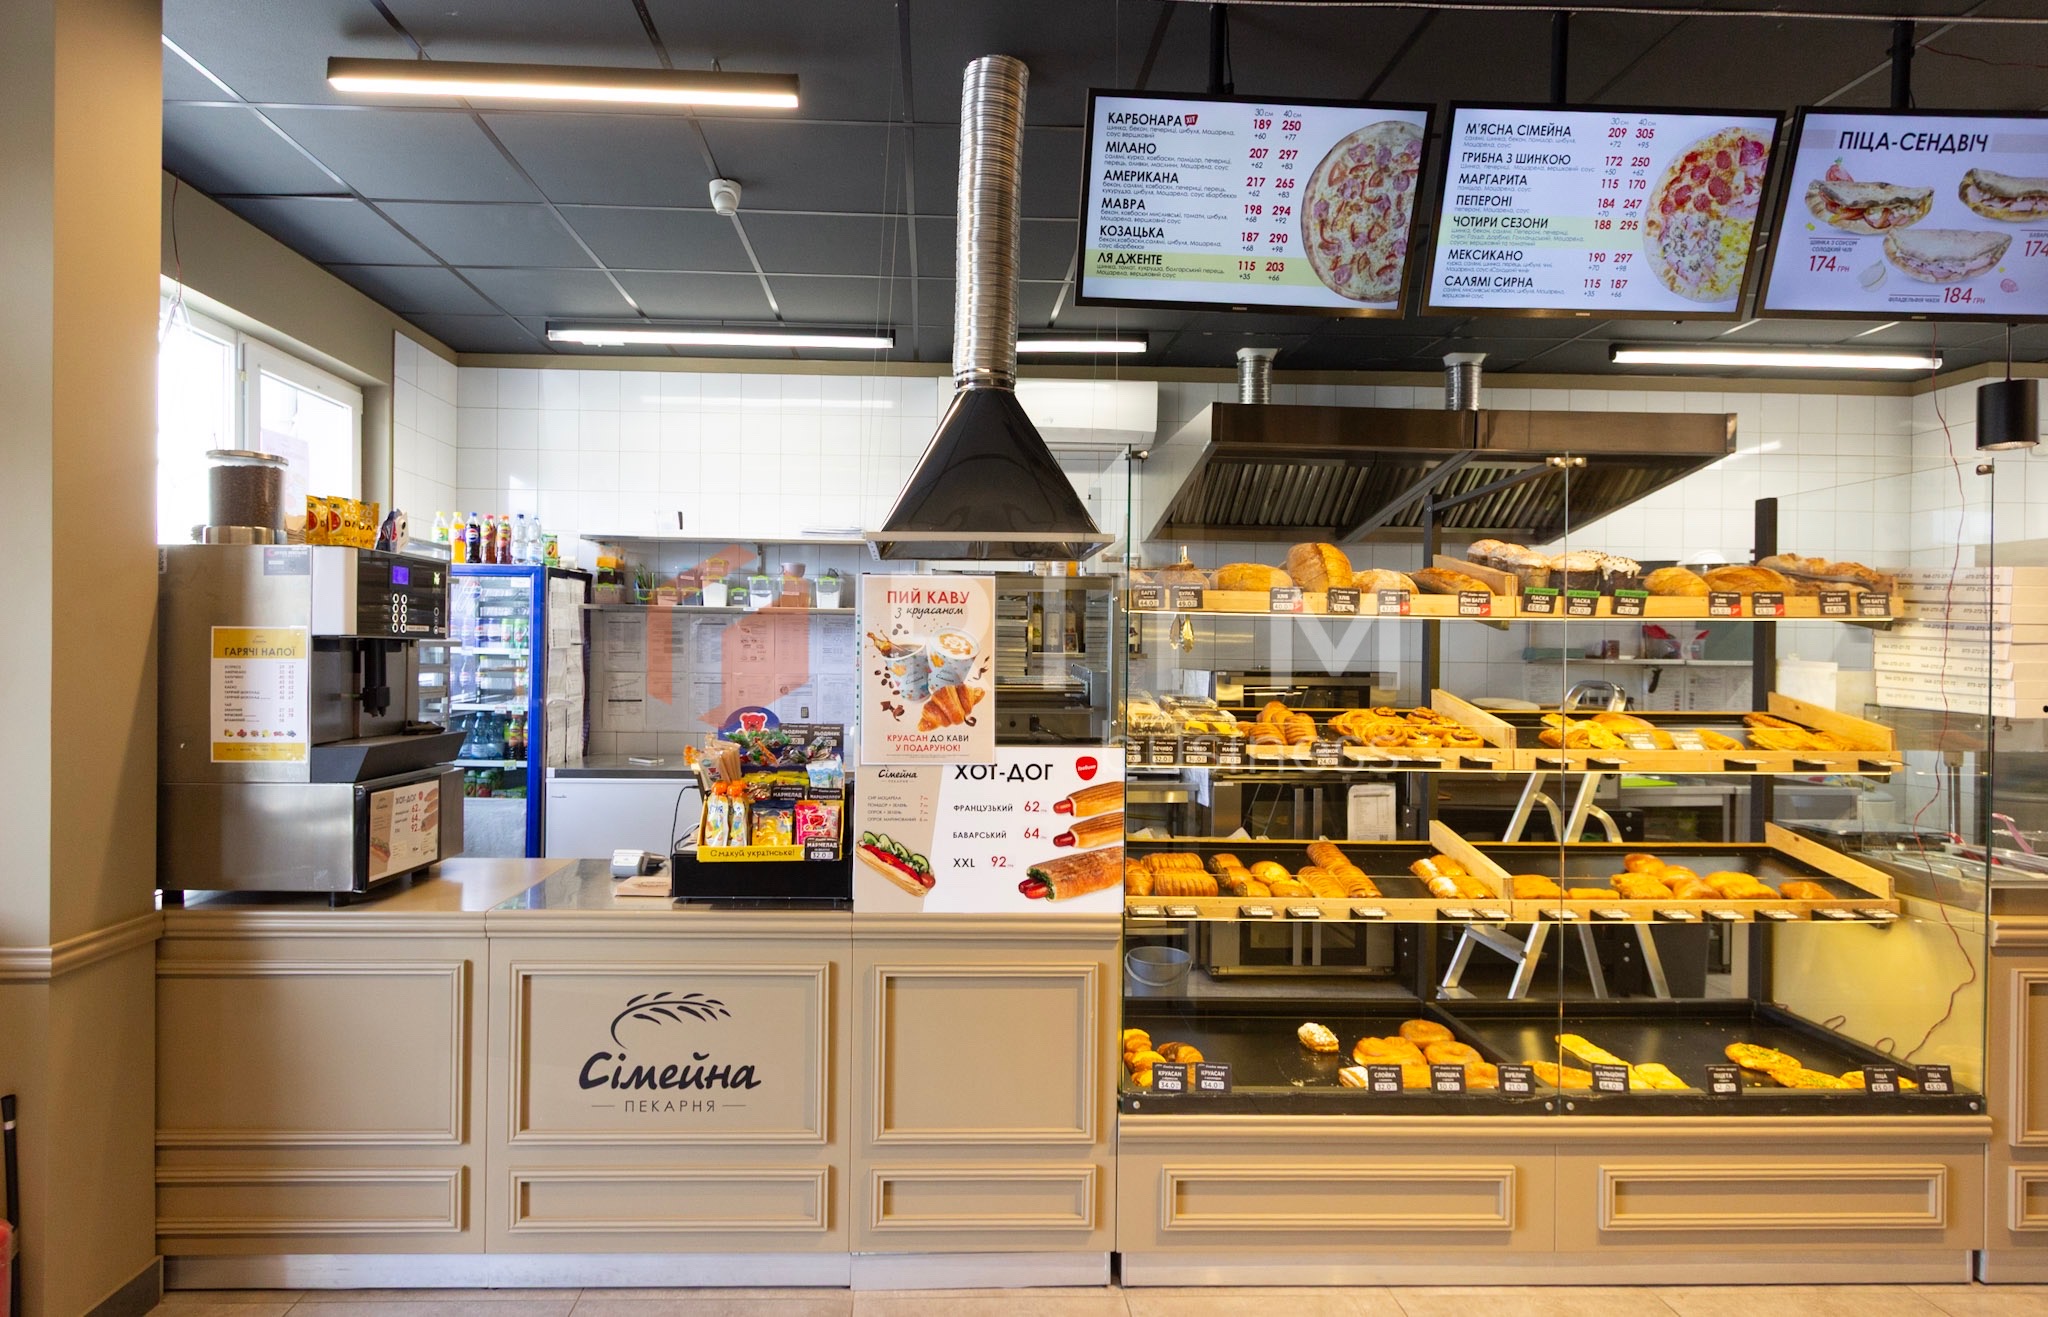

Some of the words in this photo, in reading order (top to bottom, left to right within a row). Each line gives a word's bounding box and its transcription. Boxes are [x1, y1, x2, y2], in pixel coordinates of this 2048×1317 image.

[1283, 110, 1292, 118] 40
[1108, 112, 1182, 127] КАРБОНАРА
[1611, 118, 1620, 126] 30
[1639, 118, 1647, 126] 40
[1254, 120, 1272, 130] 189
[1282, 120, 1301, 131] 250
[1466, 123, 1513, 136] М'ЯСНА
[1517, 122, 1572, 137] СІМЕЙНА
[1608, 128, 1627, 138] 209
[1636, 128, 1654, 139] 305
[1839, 130, 1989, 154] ПІЦА-СЕНДВІЧ
[1106, 141, 1156, 154] МІЛАНО
[1249, 148, 1269, 159] 207
[1279, 150, 1298, 160] 297
[1462, 152, 1502, 163] ГРИБНА
[1516, 153, 1571, 165] ШИНКОЮ
[1605, 157, 1623, 166] 172
[1631, 157, 1650, 167] 250
[1104, 170, 1179, 184] АМЕРИКАНА
[1246, 177, 1265, 187] 217
[1459, 173, 1528, 186] МАРГАРИТА
[1275, 178, 1294, 188] 265
[1602, 179, 1619, 189] 115
[1629, 180, 1646, 190] 170
[1101, 198, 1146, 210] МАВРА
[1456, 195, 1512, 207] ПЕПЕРОНІ
[1598, 198, 1615, 208] 184
[1623, 199, 1642, 209] 247
[1244, 205, 1262, 215] 198
[1272, 206, 1291, 216] 294
[1453, 216, 1498, 228] ЧОТИРИ
[1501, 217, 1548, 229] СЕЗОНИ
[1594, 220, 1611, 229] 188
[1620, 220, 1638, 230] 295
[1100, 225, 1164, 238] КОЗАЦЬКА
[1242, 232, 1259, 242] 187
[1269, 234, 1288, 244] 290
[1097, 253, 1113, 263] ЛЯ
[1116, 254, 1162, 266] ДЖЕНТЕ
[1448, 250, 1523, 261] МЕКСИКАНО
[1588, 253, 1605, 263] 190
[1614, 253, 1632, 263] 297
[1238, 261, 1256, 271] 115
[1266, 262, 1284, 272] 203
[1809, 255, 1836, 272] 174
[1444, 275, 1491, 287] САЛЯМІ
[1494, 276, 1533, 288] СИРНА
[1584, 279, 1601, 288] 115
[1610, 279, 1628, 289] 187
[1943, 287, 1972, 303] 184
[887, 588, 921, 604] ПИЙ
[927, 591, 970, 604] КАВУ
[906, 606, 964, 619] круасаном
[224, 648, 258, 656] ГАРЯЧІ
[261, 646, 295, 656] НАПОЇ
[887, 734, 928, 742] КРУАСАН
[930, 734, 944, 743] ДО
[946, 734, 969, 742] КАВИ
[896, 744, 902, 752] У
[903, 744, 961, 753] ПОДАРУНОК!
[878, 769, 918, 778] Сімейна
[955, 764, 1054, 782] ХОТ-ДОГ
[953, 803, 1013, 813] ФРАНЦУЗЬКИЙ
[1024, 801, 1040, 813] 62
[953, 830, 1007, 839] БАВАРСЬКИЙ
[1024, 828, 1040, 839] 64
[748, 849, 795, 858] українське!
[953, 859, 976, 868] XXL
[991, 856, 1006, 868] 92
[579, 1051, 762, 1090] Сімейна
[625, 1100, 715, 1113] ПЕКАРНЯ
